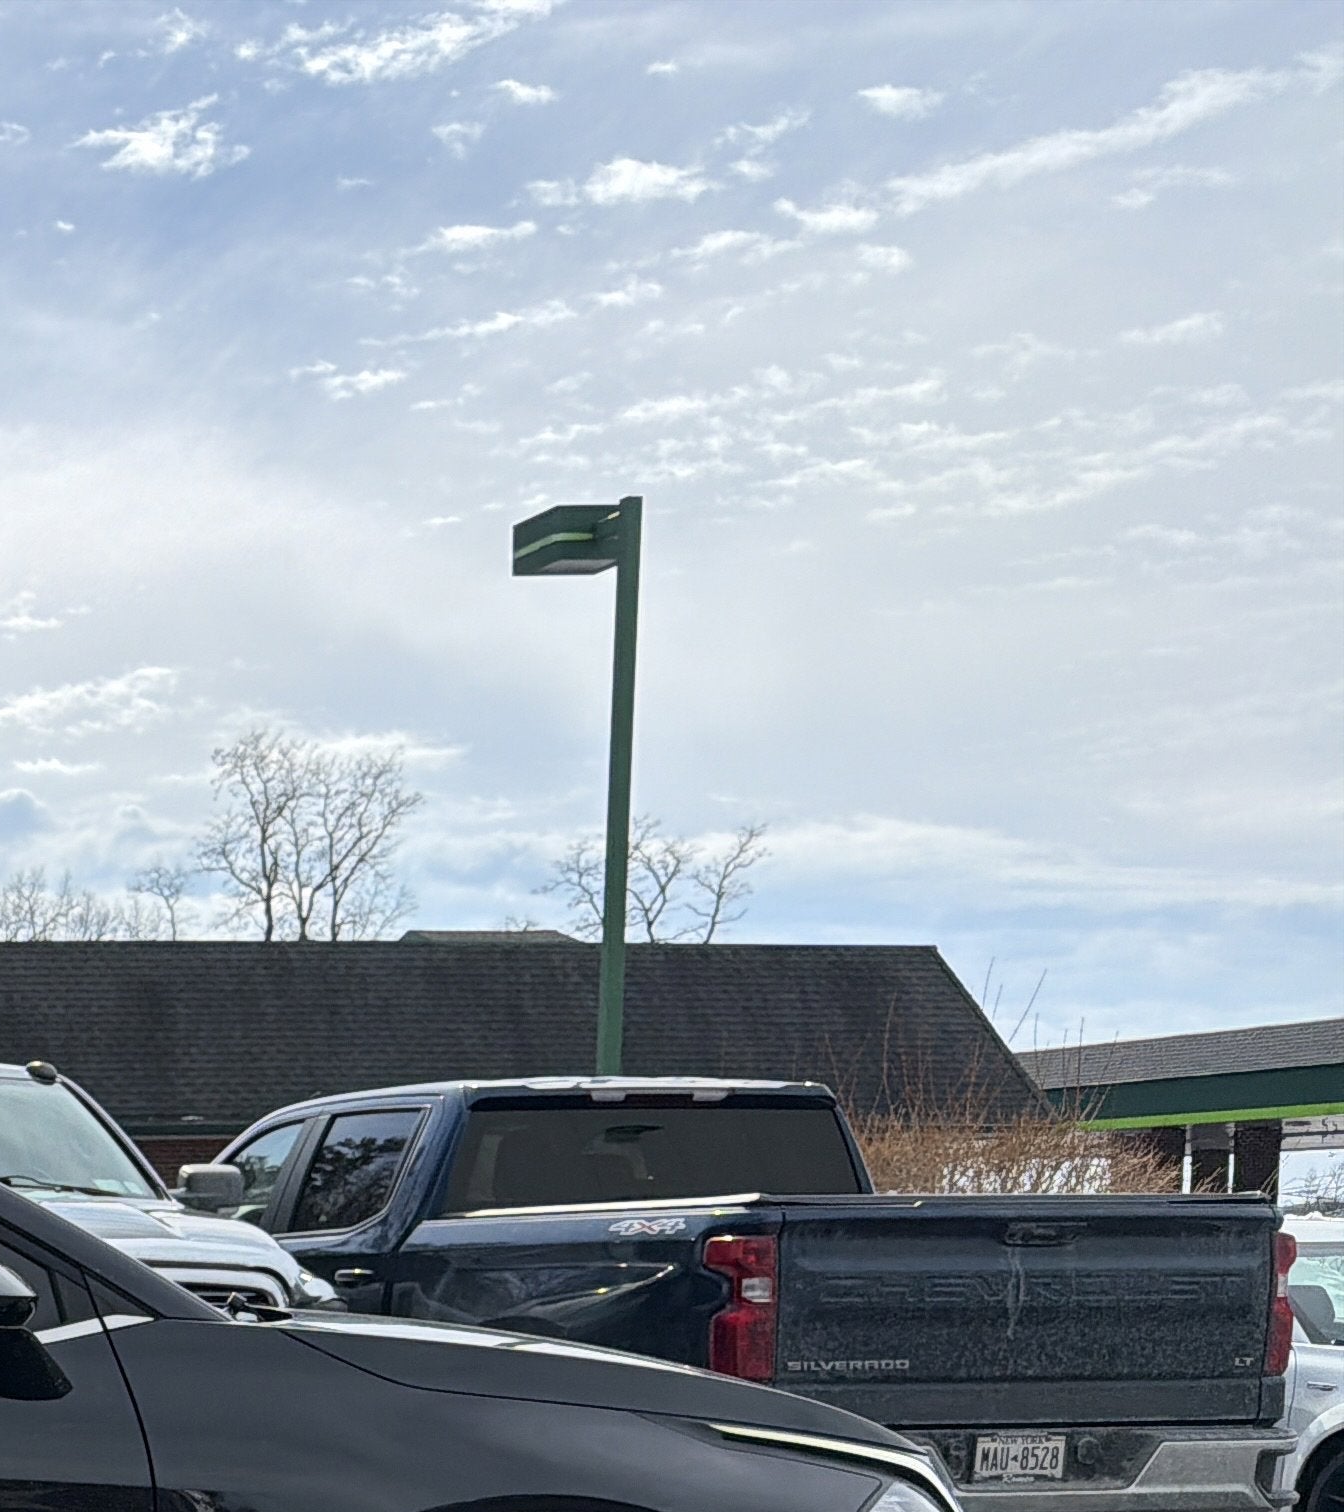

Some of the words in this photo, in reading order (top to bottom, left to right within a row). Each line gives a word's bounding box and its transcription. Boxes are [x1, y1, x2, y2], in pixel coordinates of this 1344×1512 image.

[787, 1360, 910, 1371] SILVERADO
[1234, 1357, 1255, 1367] LT
[998, 1435, 1018, 1445] NEW
[1021, 1434, 1045, 1445] YORK
